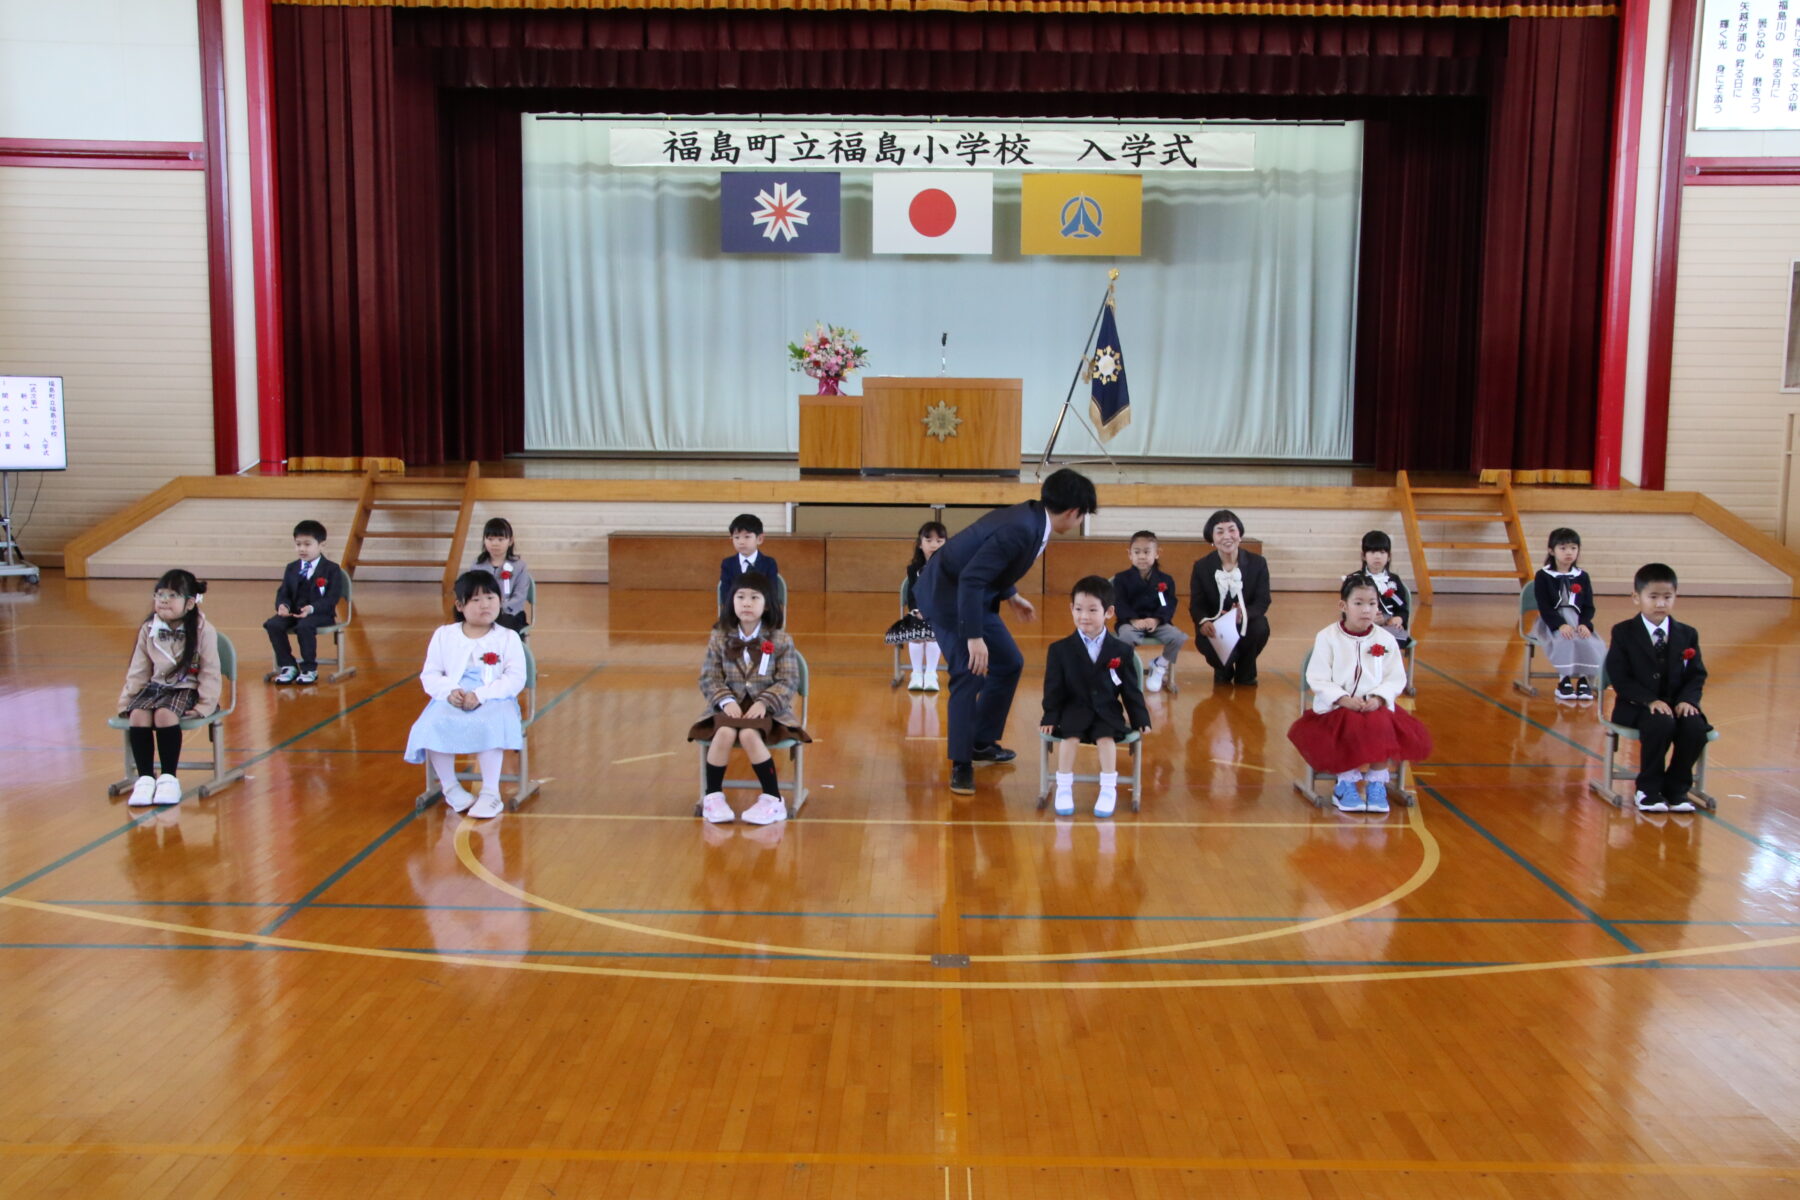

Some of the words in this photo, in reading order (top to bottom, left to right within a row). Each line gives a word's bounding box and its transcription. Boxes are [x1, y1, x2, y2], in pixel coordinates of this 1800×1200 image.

[1718, 19, 1730, 50] 輝く光
[1775, 0, 1788, 41] 福島川の
[1770, 58, 1783, 98] 照る月に
[662, 129, 1032, 167] 福島町立福島小学校
[1075, 131, 1199, 169] 入学式
